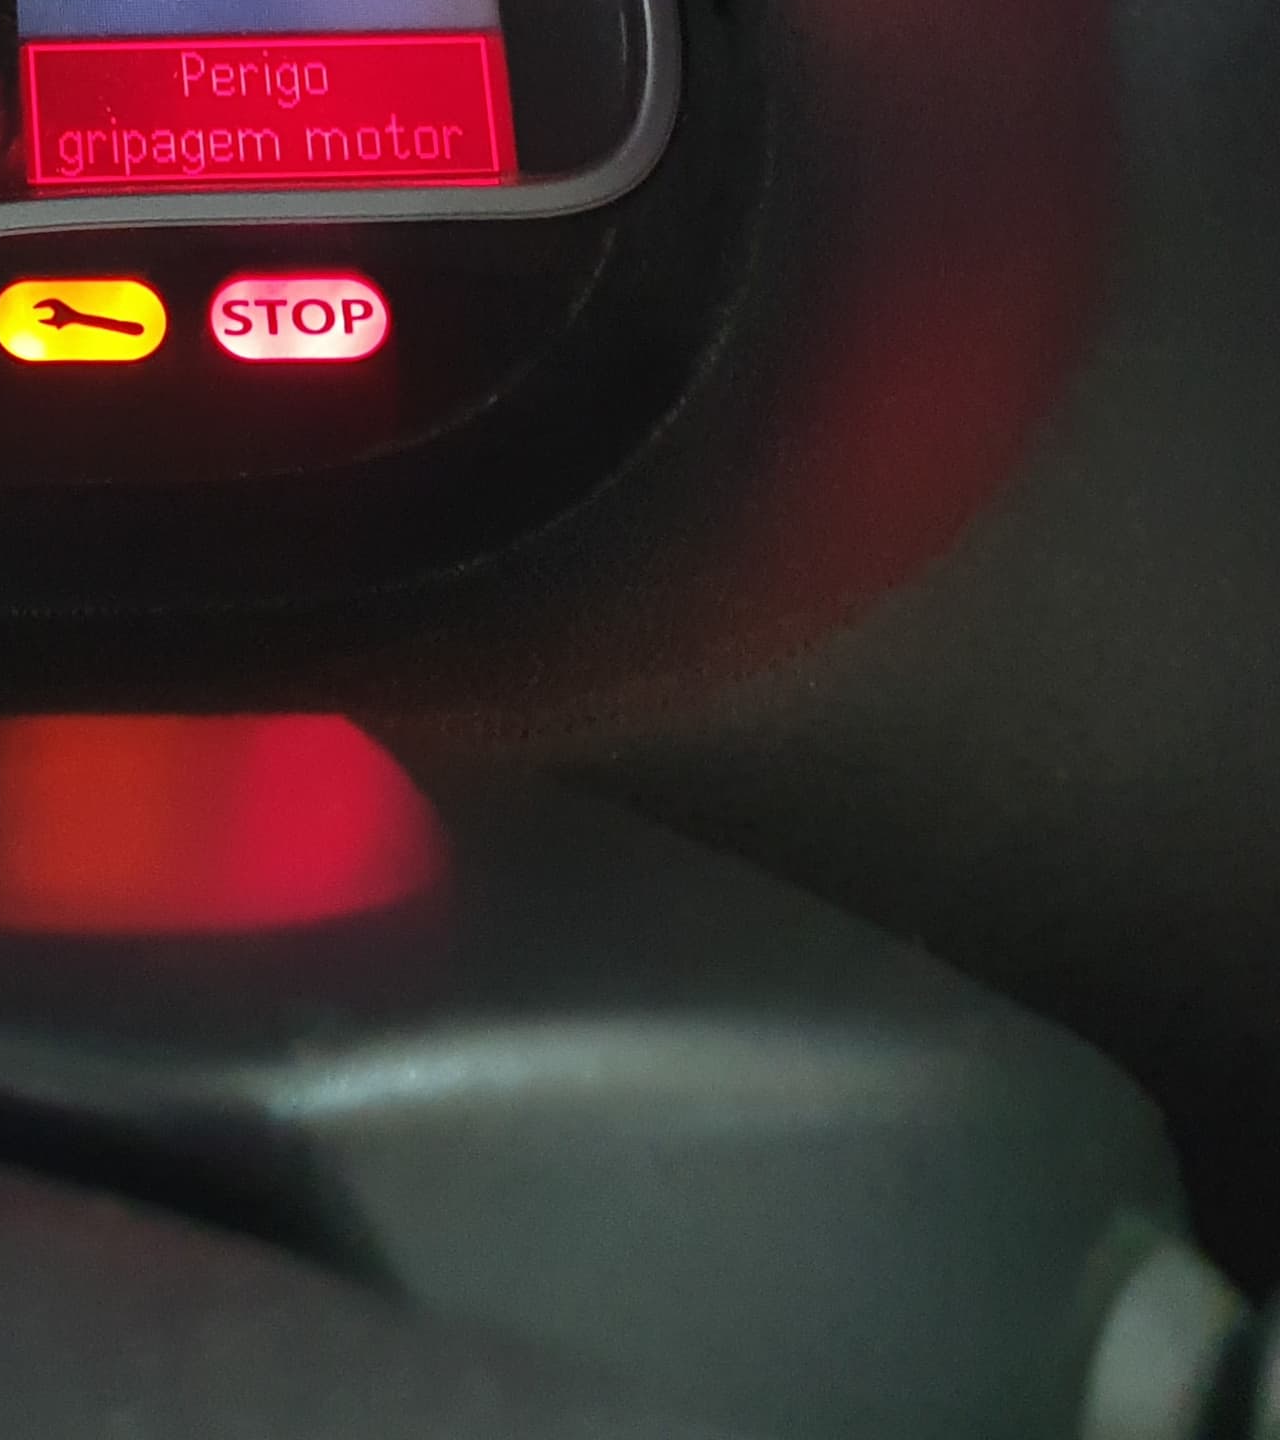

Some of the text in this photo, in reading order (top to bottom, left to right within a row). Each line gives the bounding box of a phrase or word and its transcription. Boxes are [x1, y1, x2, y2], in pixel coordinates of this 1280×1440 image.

[180, 50, 330, 108] Perigo
[57, 115, 464, 177] gripagem motor
[220, 298, 374, 336] STOP
